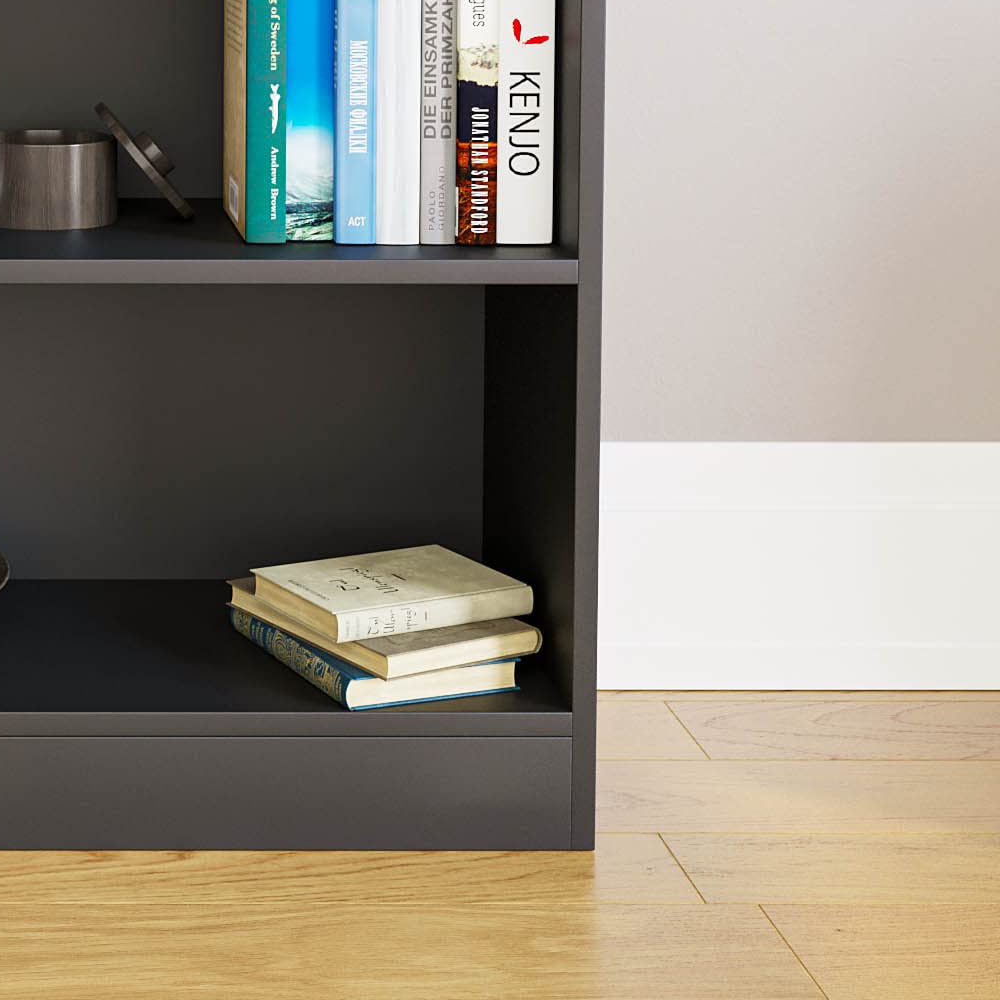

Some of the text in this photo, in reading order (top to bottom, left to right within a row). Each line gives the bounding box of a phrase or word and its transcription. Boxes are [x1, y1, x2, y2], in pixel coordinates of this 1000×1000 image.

[269, 7, 281, 20] of
[269, 22, 281, 71] Sweden
[348, 41, 368, 153] МОСКОВСКИЕ ФИАЛКИ
[423, 105, 437, 139] DIE
[440, 96, 453, 139] DER
[509, 72, 540, 176] KENJO
[270, 147, 279, 220] Andrew Brown
[472, 107, 489, 234] JONATHAN STANDFORD
